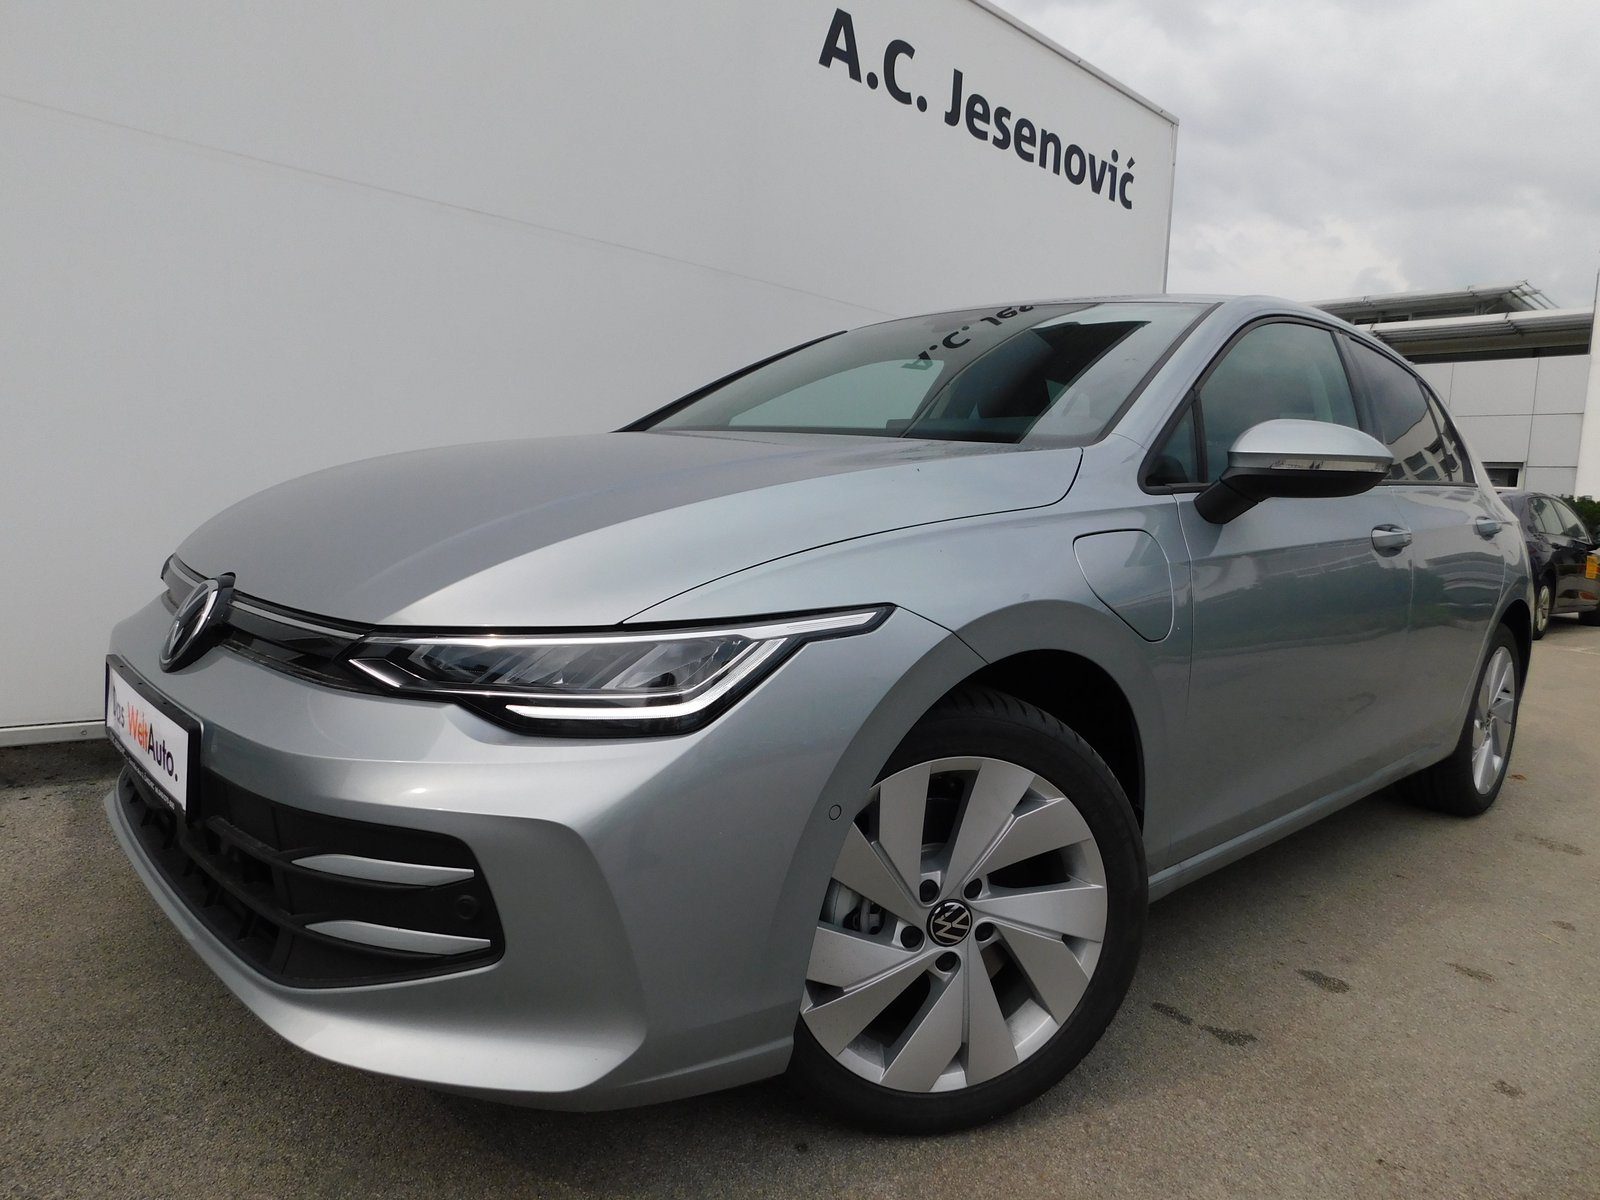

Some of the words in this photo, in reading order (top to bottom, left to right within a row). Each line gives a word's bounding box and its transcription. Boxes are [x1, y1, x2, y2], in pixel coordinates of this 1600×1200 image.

[818, 8, 928, 112] A.C.
[944, 68, 1136, 210] Jesenović
[127, 701, 178, 783] WeltAuto.
[930, 902, 970, 944] VW
